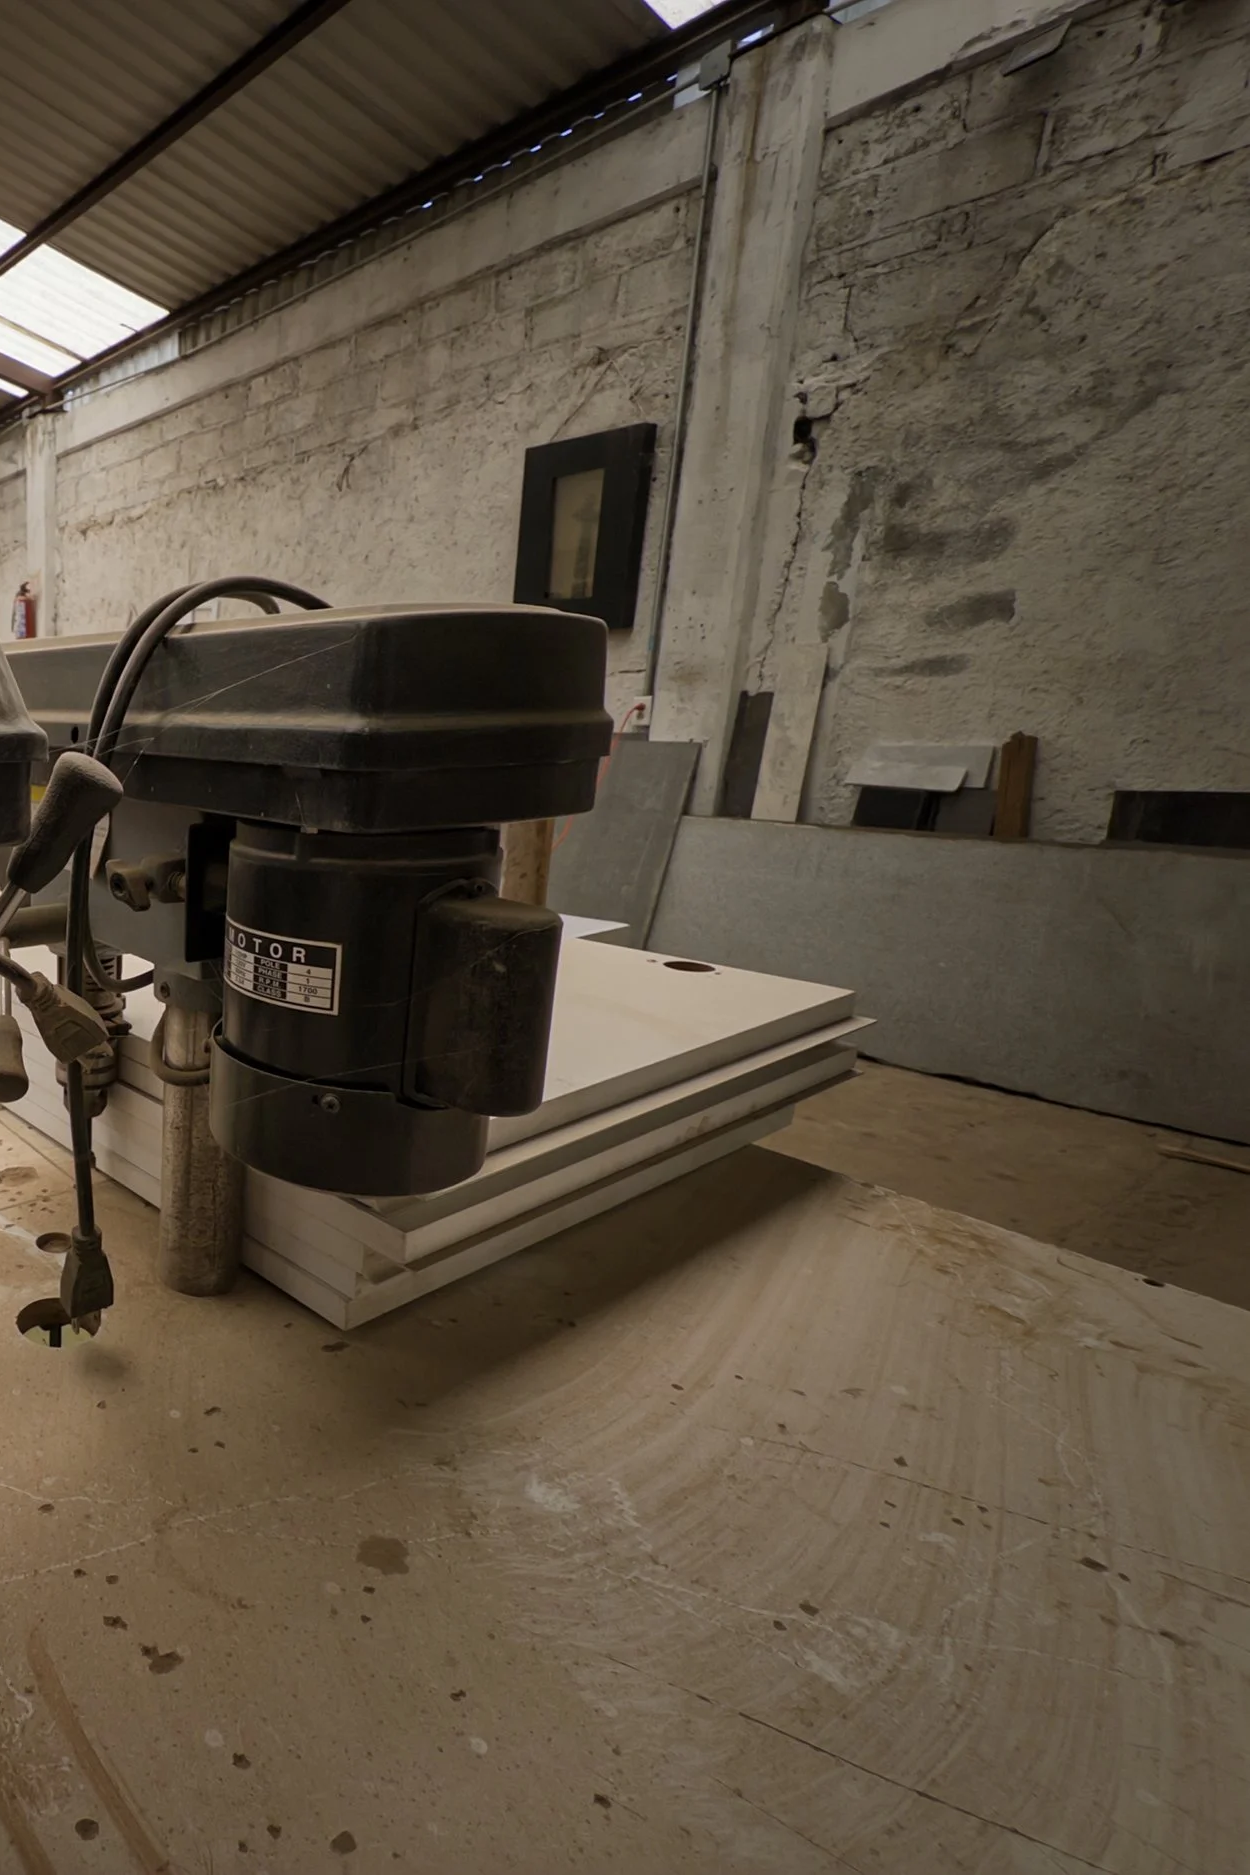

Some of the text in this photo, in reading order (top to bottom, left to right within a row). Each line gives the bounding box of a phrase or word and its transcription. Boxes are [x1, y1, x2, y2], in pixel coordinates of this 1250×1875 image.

[228, 927, 307, 963] MOTOR
[260, 959, 281, 970] POLE
[257, 967, 282, 979] PHASE
[257, 985, 282, 998] CLASS
[298, 986, 318, 995] 1700
